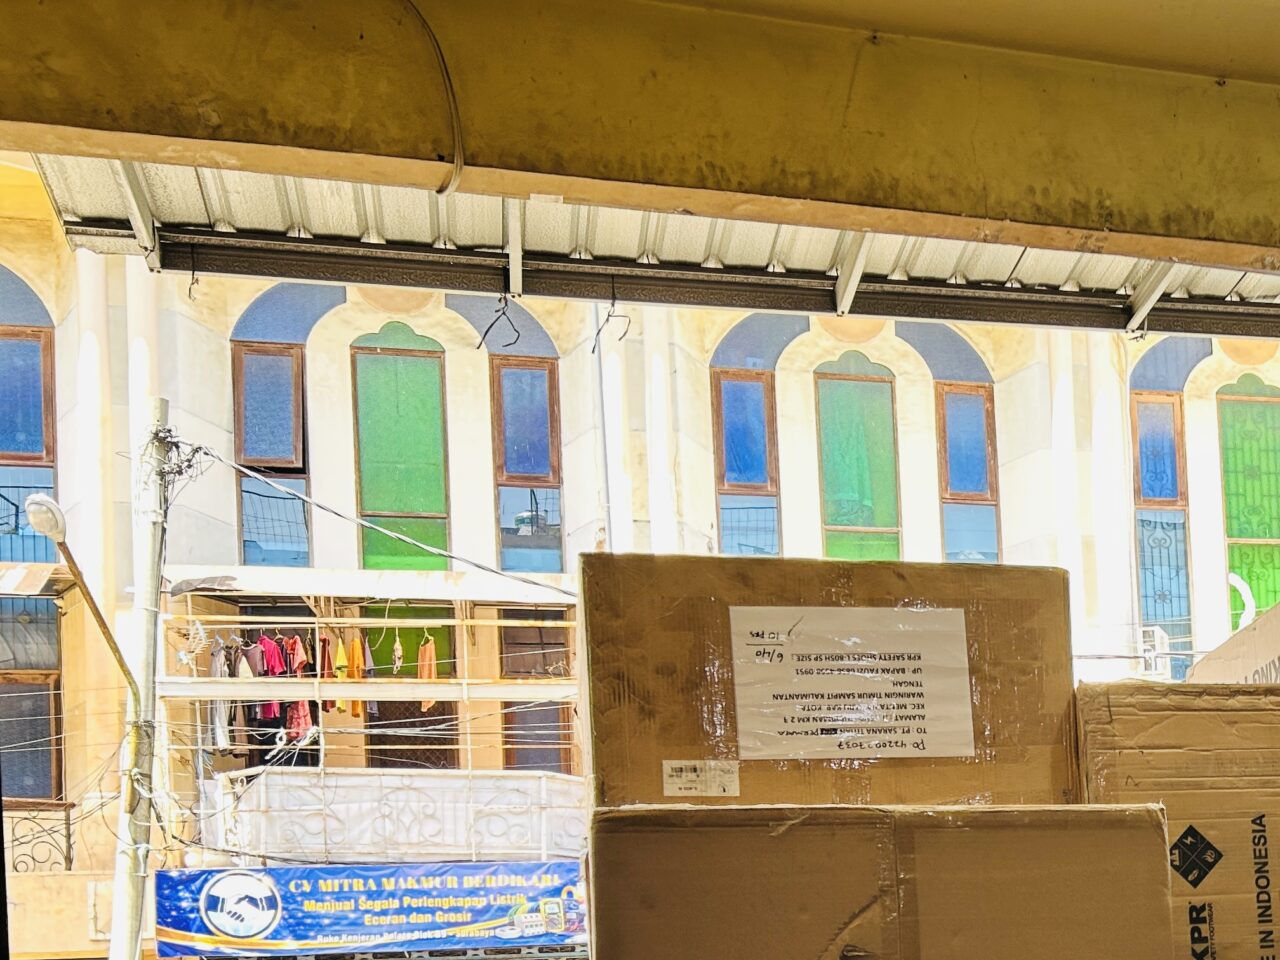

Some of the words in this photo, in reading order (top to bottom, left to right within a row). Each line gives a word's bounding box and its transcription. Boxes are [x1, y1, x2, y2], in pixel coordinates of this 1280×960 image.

[1251, 814, 1273, 924] INDONESIA
[288, 879, 313, 893] CV
[318, 878, 377, 892] MITRA
[381, 875, 458, 891] MAKMUR
[303, 898, 355, 913] Menjual
[358, 897, 400, 911] Segala
[489, 893, 528, 906] Listrik
[364, 914, 406, 926] Eceran
[409, 912, 432, 924] dan
[435, 911, 472, 923] Grosir
[1258, 930, 1275, 949] IN
